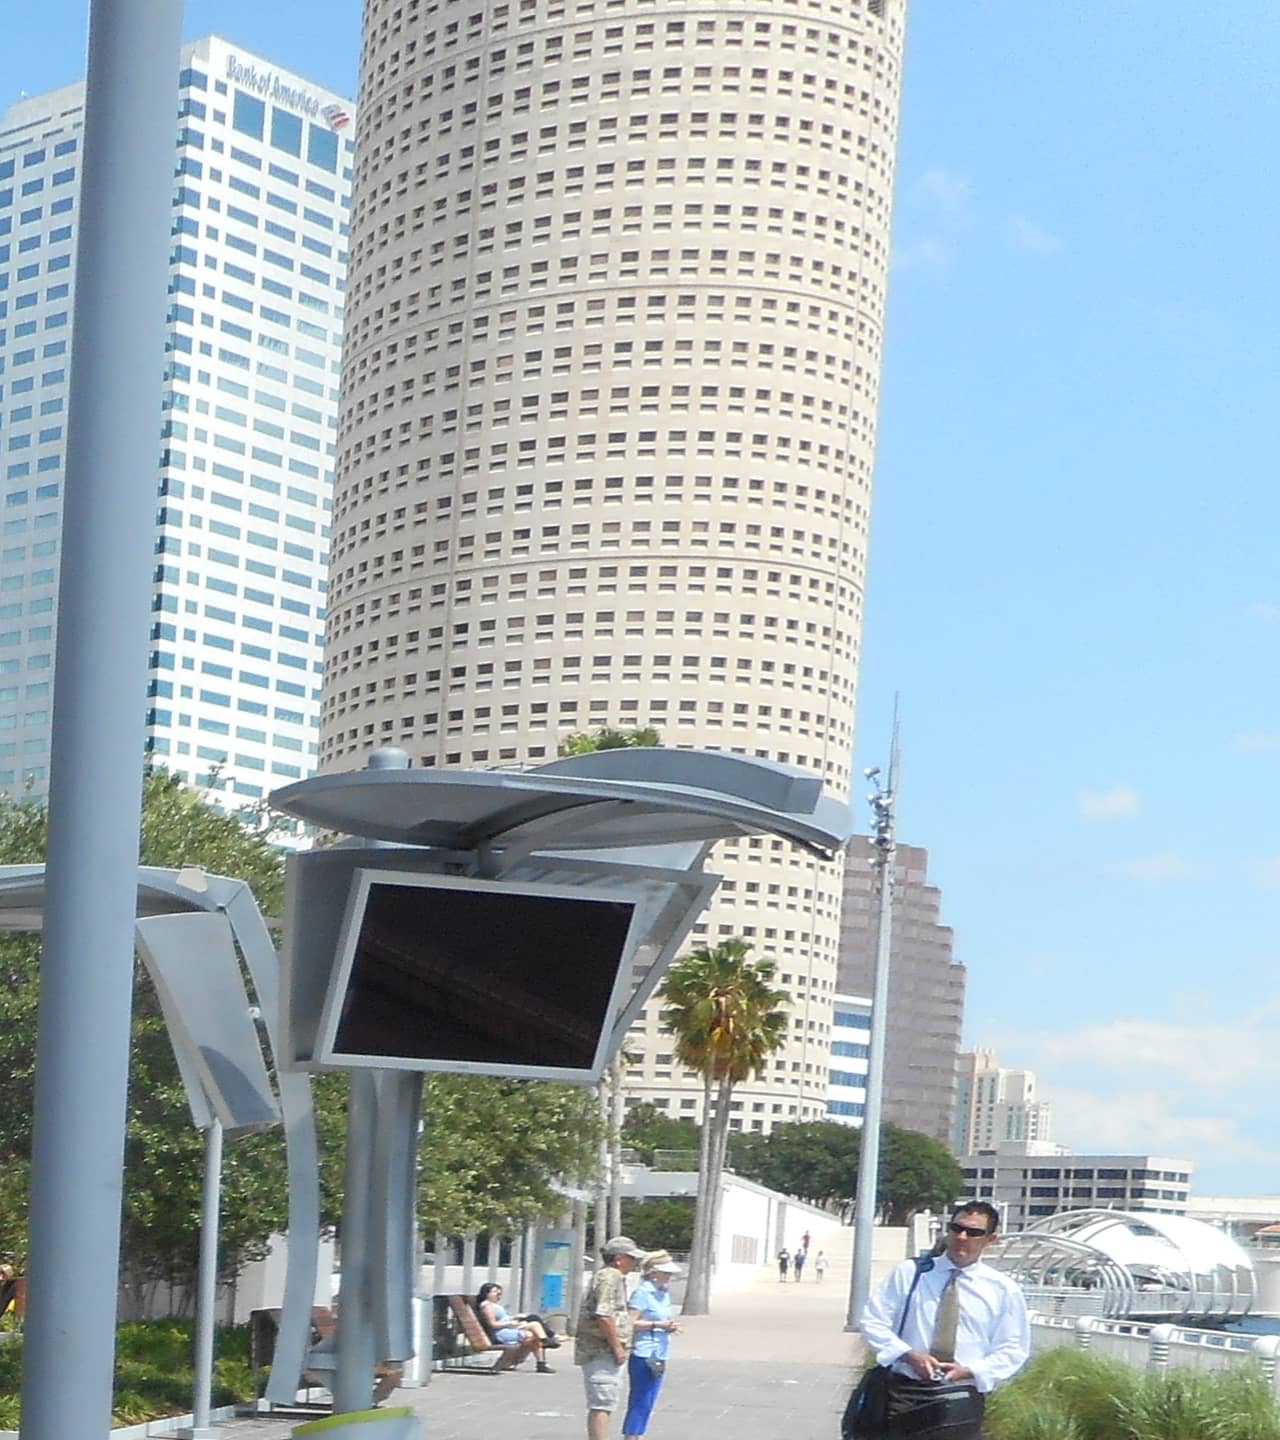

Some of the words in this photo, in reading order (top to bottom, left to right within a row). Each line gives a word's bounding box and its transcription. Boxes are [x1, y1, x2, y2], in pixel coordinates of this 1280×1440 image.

[227, 55, 258, 89] Bank
[258, 71, 271, 95] of
[271, 75, 319, 116] America
